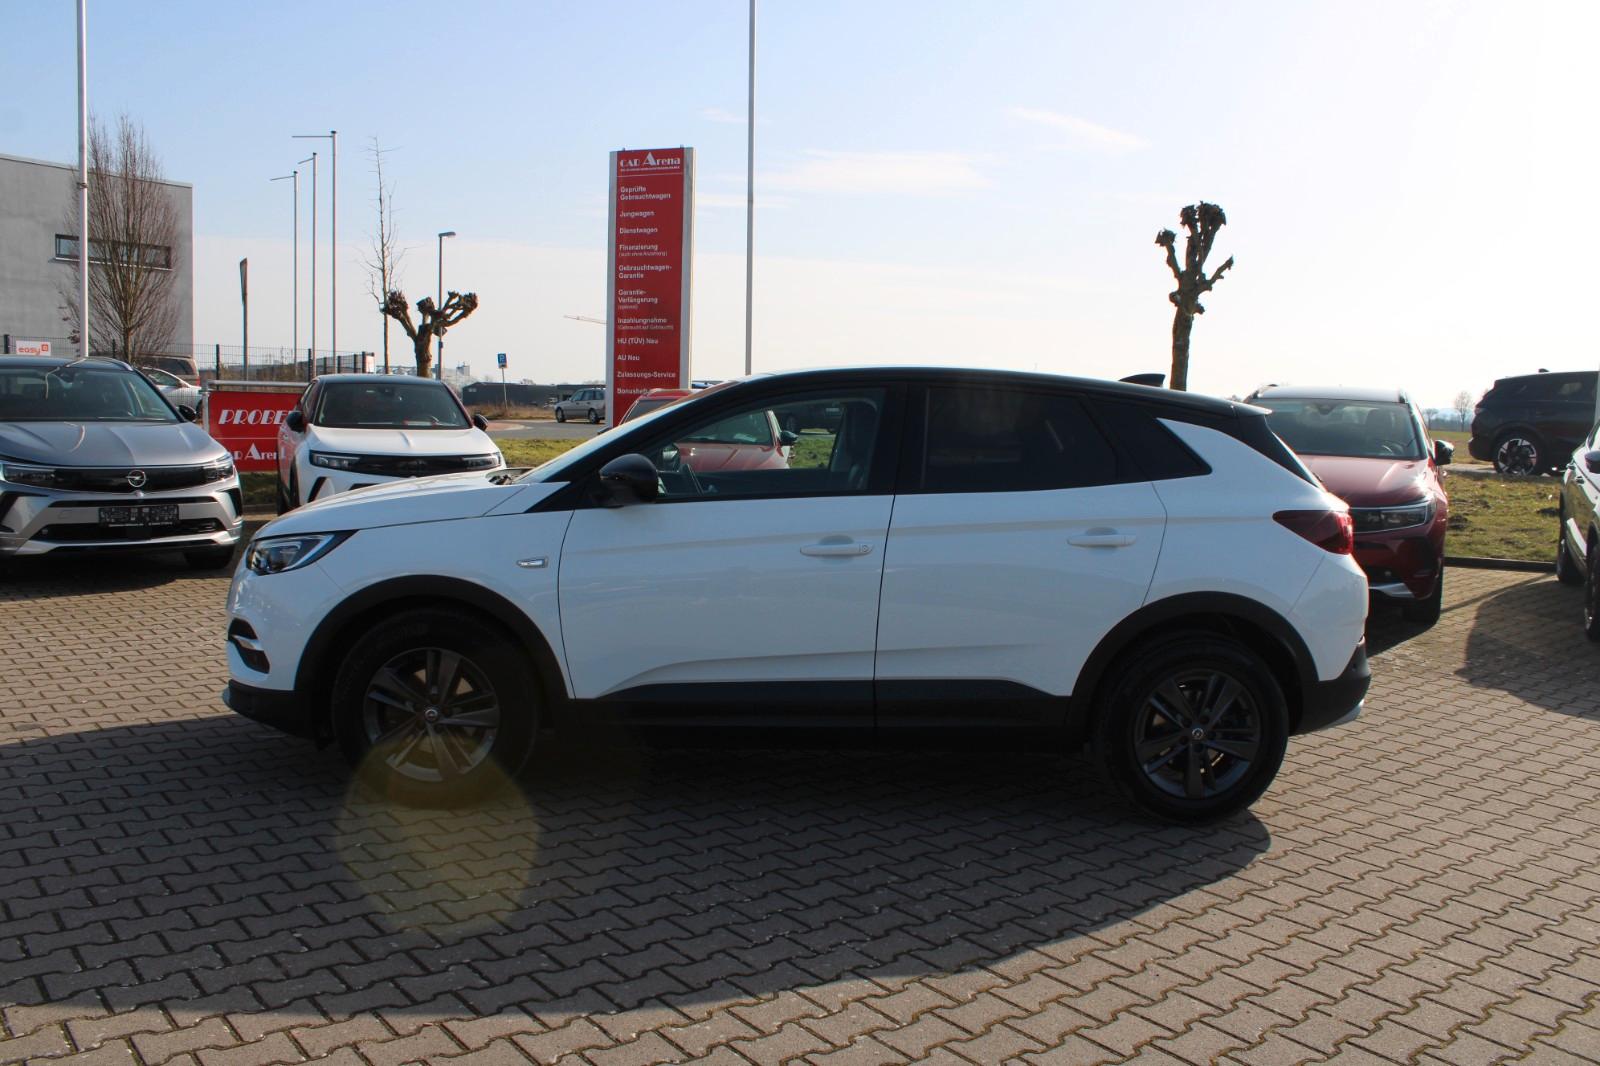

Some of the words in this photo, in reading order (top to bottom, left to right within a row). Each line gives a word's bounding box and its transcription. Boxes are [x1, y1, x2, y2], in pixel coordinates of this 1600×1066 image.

[643, 152, 680, 166] Arena
[620, 185, 646, 193] Geprüfte
[620, 210, 655, 218] Jungwagen
[628, 336, 645, 345] (TÜV)
[617, 371, 676, 379] Zulassungs-Service
[218, 409, 292, 424] PROBE
